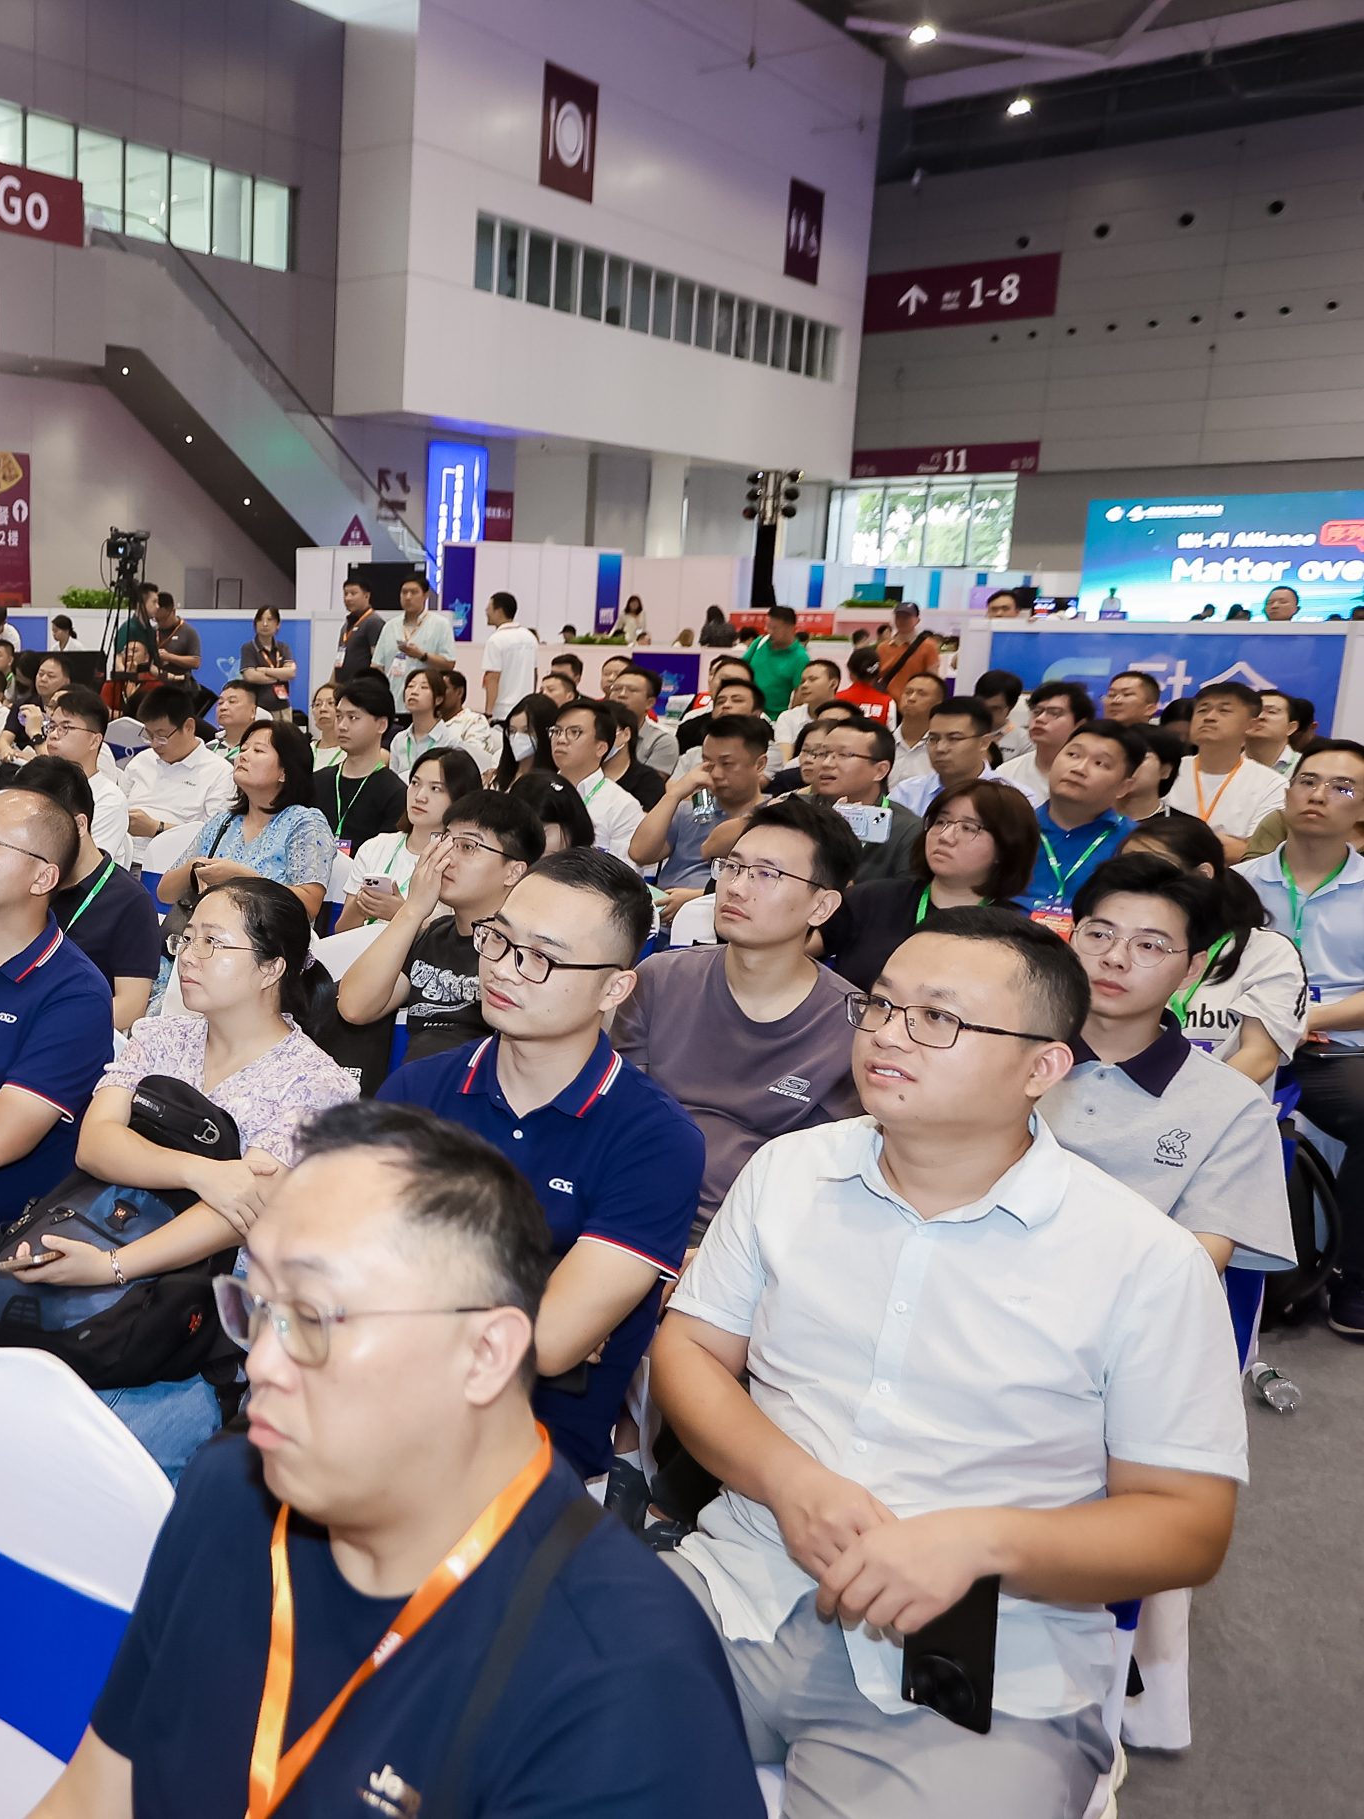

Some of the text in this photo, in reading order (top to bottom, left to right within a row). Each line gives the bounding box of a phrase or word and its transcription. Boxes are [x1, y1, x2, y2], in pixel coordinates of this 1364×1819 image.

[968, 273, 1021, 311] 1-8
[942, 448, 967, 473] 11
[1177, 532, 1230, 549] Wi-Fi
[1231, 530, 1317, 549] Alliance
[1171, 556, 1364, 584] Matter ove
[768, 1086, 812, 1103] SKECHERS
